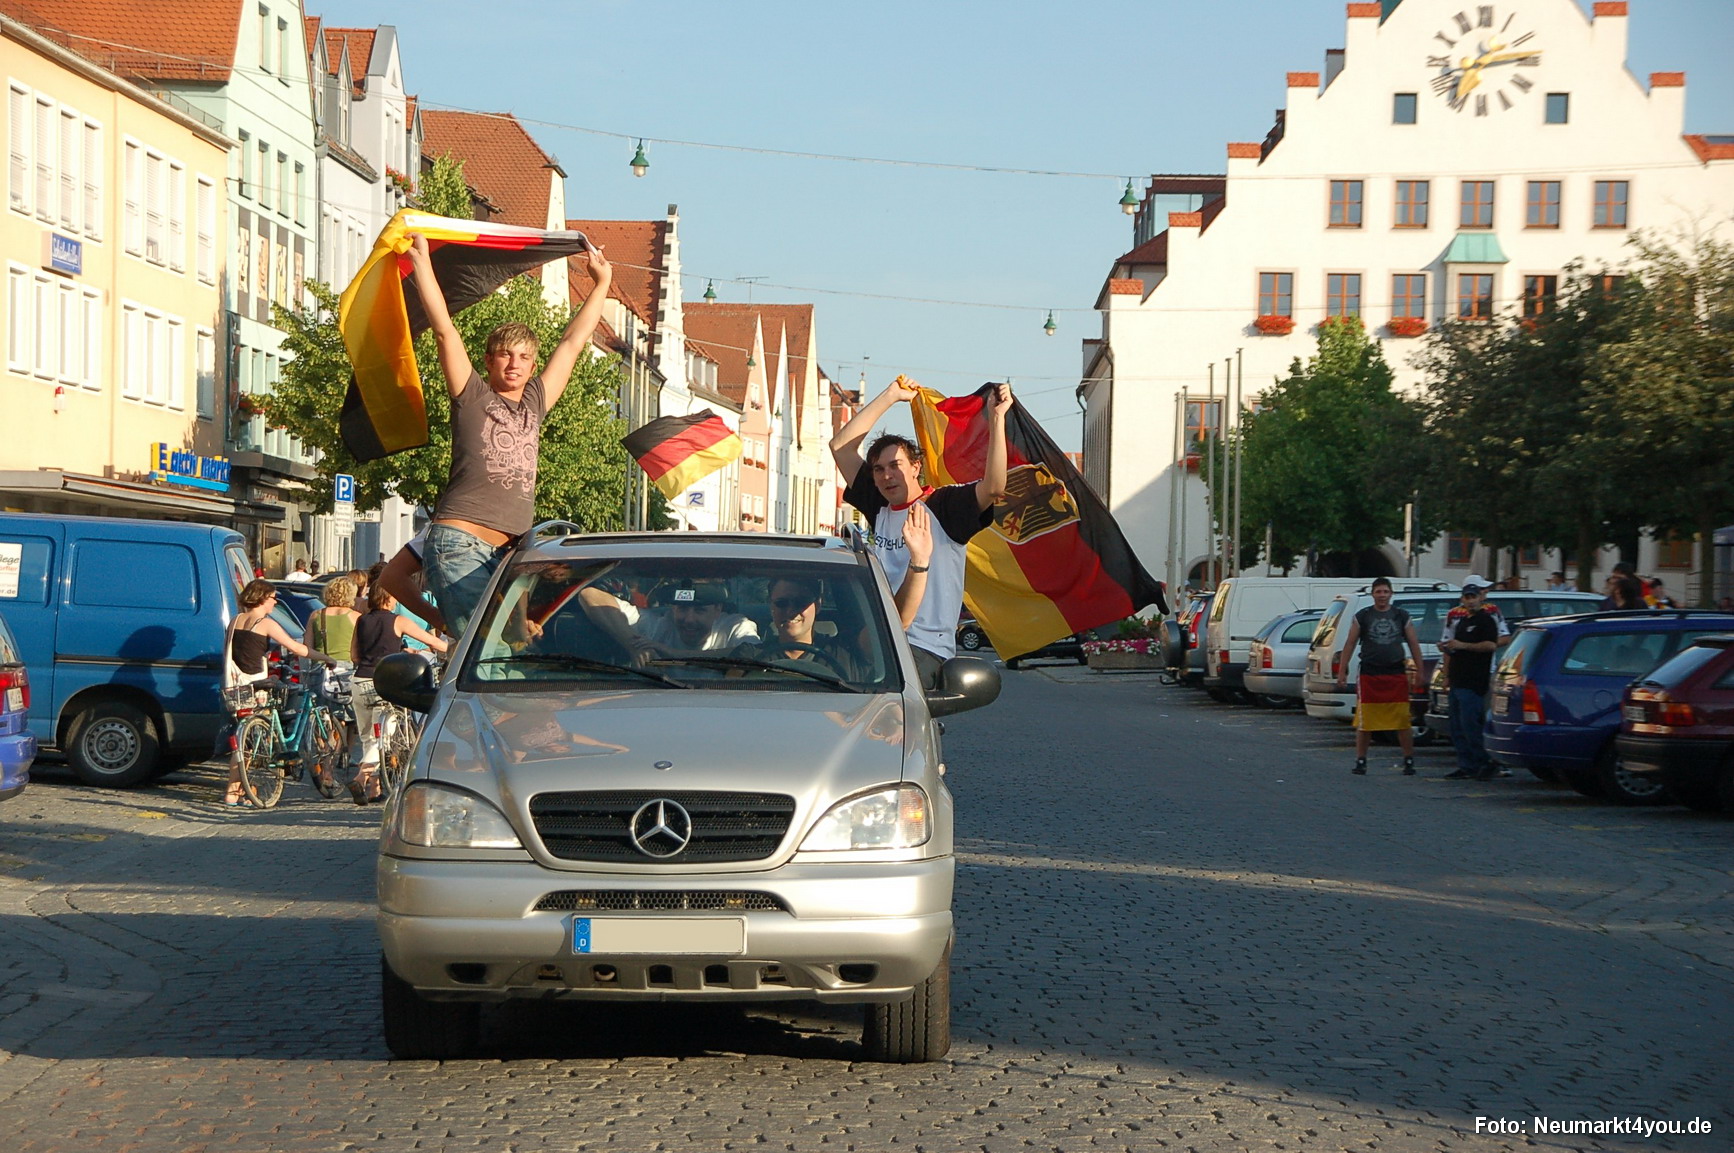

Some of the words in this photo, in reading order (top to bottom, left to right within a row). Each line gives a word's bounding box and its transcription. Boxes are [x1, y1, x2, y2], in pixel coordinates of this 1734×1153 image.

[339, 478, 349, 499] P
[689, 492, 703, 505] R
[580, 938, 586, 946] D
